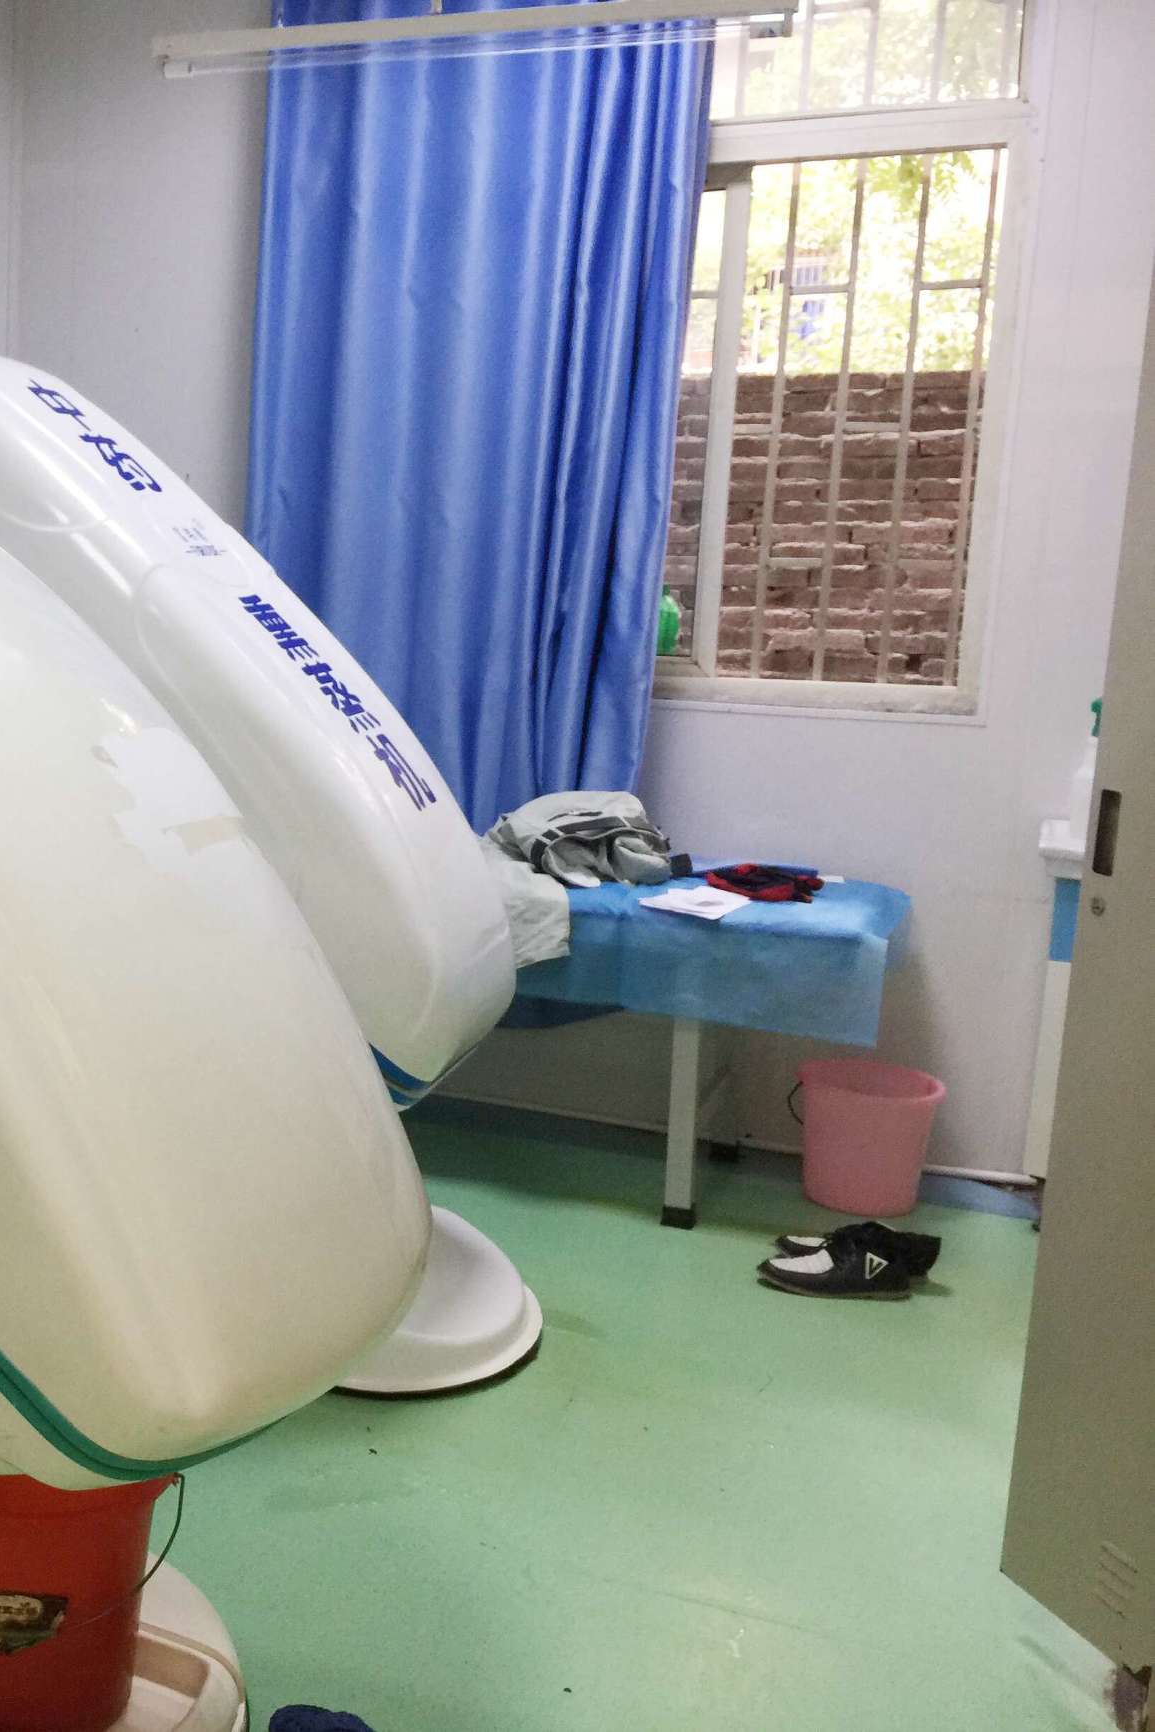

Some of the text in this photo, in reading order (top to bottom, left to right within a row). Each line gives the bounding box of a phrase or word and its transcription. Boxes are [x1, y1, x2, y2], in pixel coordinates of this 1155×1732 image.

[29, 382, 162, 492] 中药
[239, 594, 436, 811] 熏蒸机
